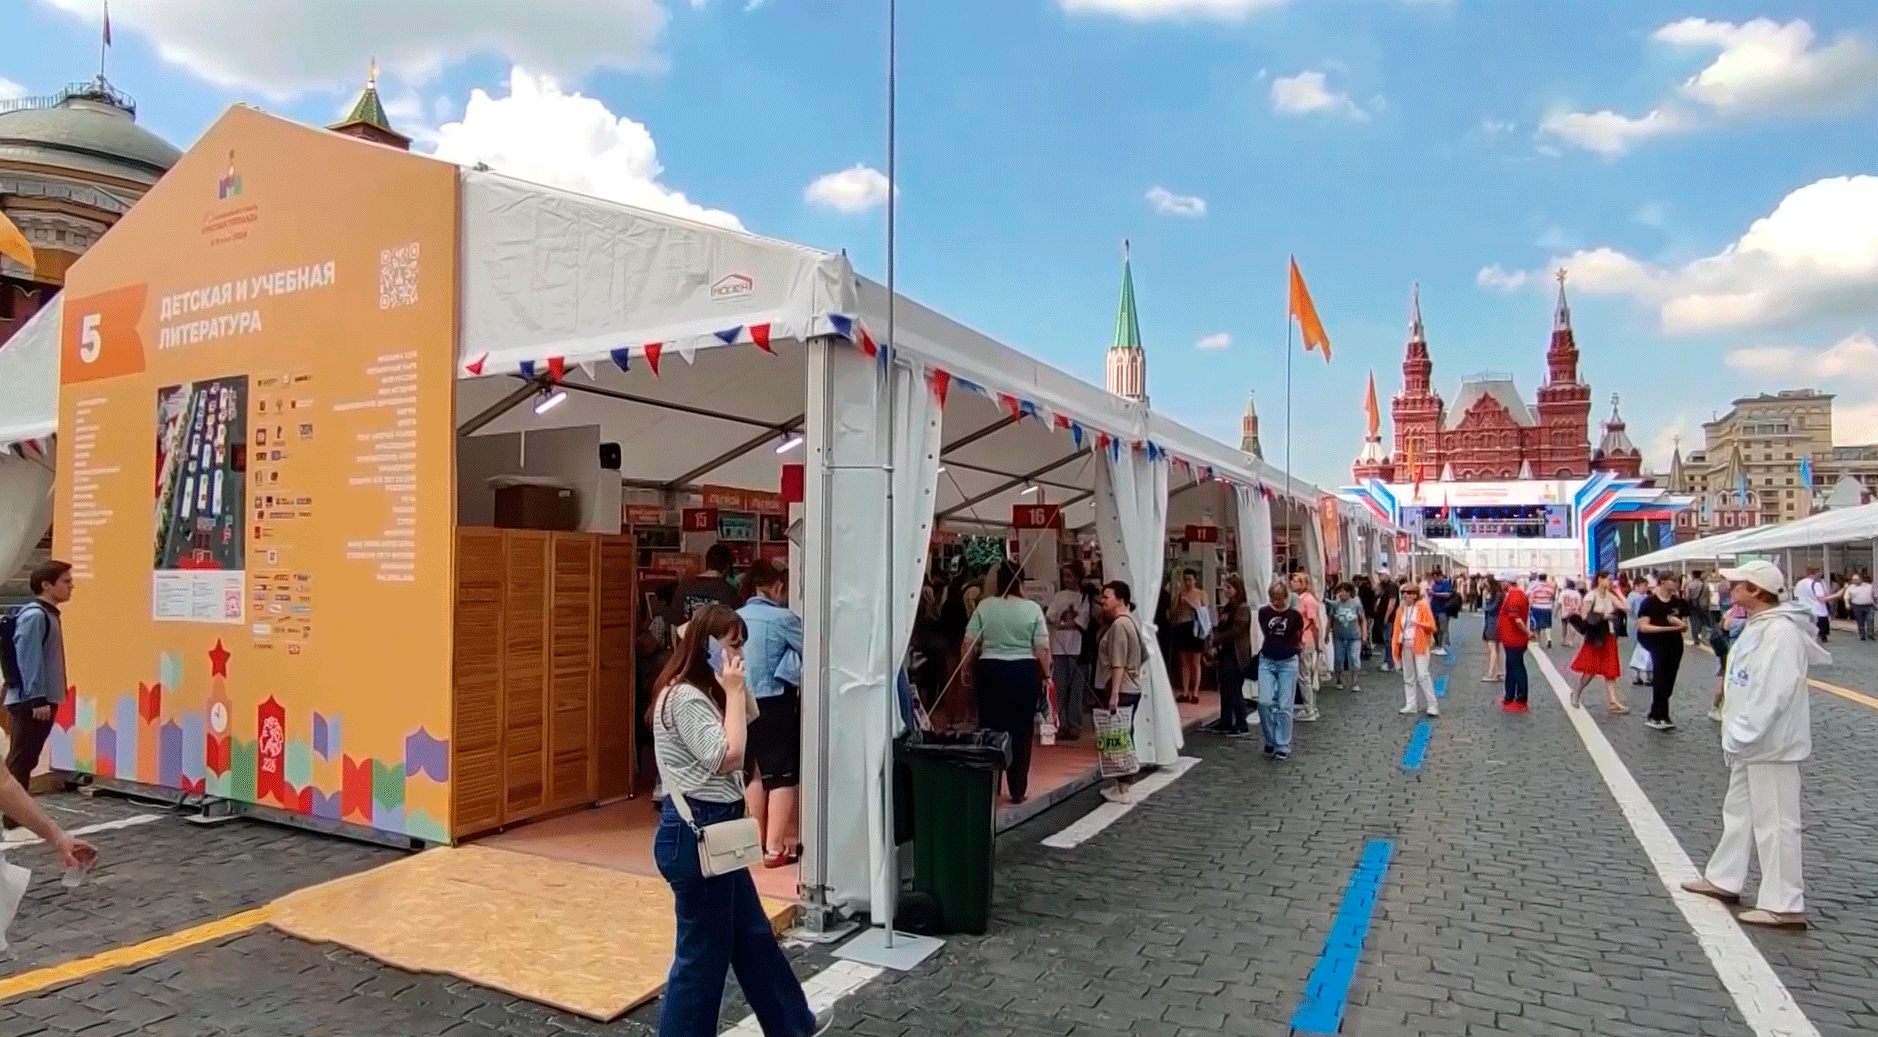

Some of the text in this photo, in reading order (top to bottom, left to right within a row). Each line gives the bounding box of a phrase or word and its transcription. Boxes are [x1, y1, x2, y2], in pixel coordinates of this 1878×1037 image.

[160, 261, 336, 321] ДЕТСКАЯ И УЧЕБНАЯ
[80, 313, 102, 364] 5
[159, 310, 262, 350] ЛИТЕРАТУРА
[695, 512, 707, 528] 15
[1028, 508, 1046, 525] 16
